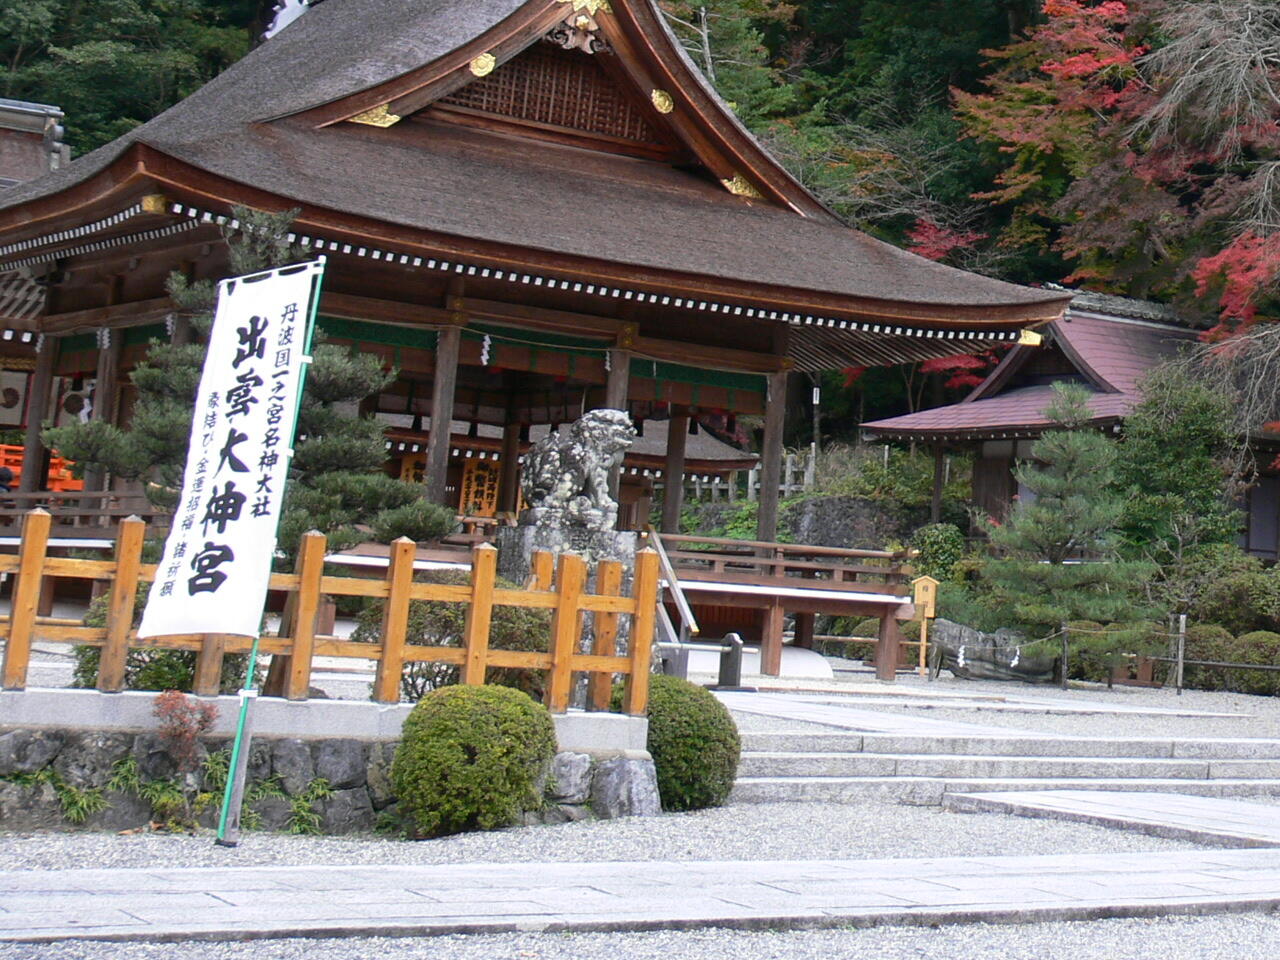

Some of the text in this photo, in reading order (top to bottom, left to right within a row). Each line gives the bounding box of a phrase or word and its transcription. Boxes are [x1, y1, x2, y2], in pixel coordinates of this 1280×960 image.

[186, 315, 268, 597] 出雲大神宮
[250, 302, 299, 518] 丹波国一之宮名神大社
